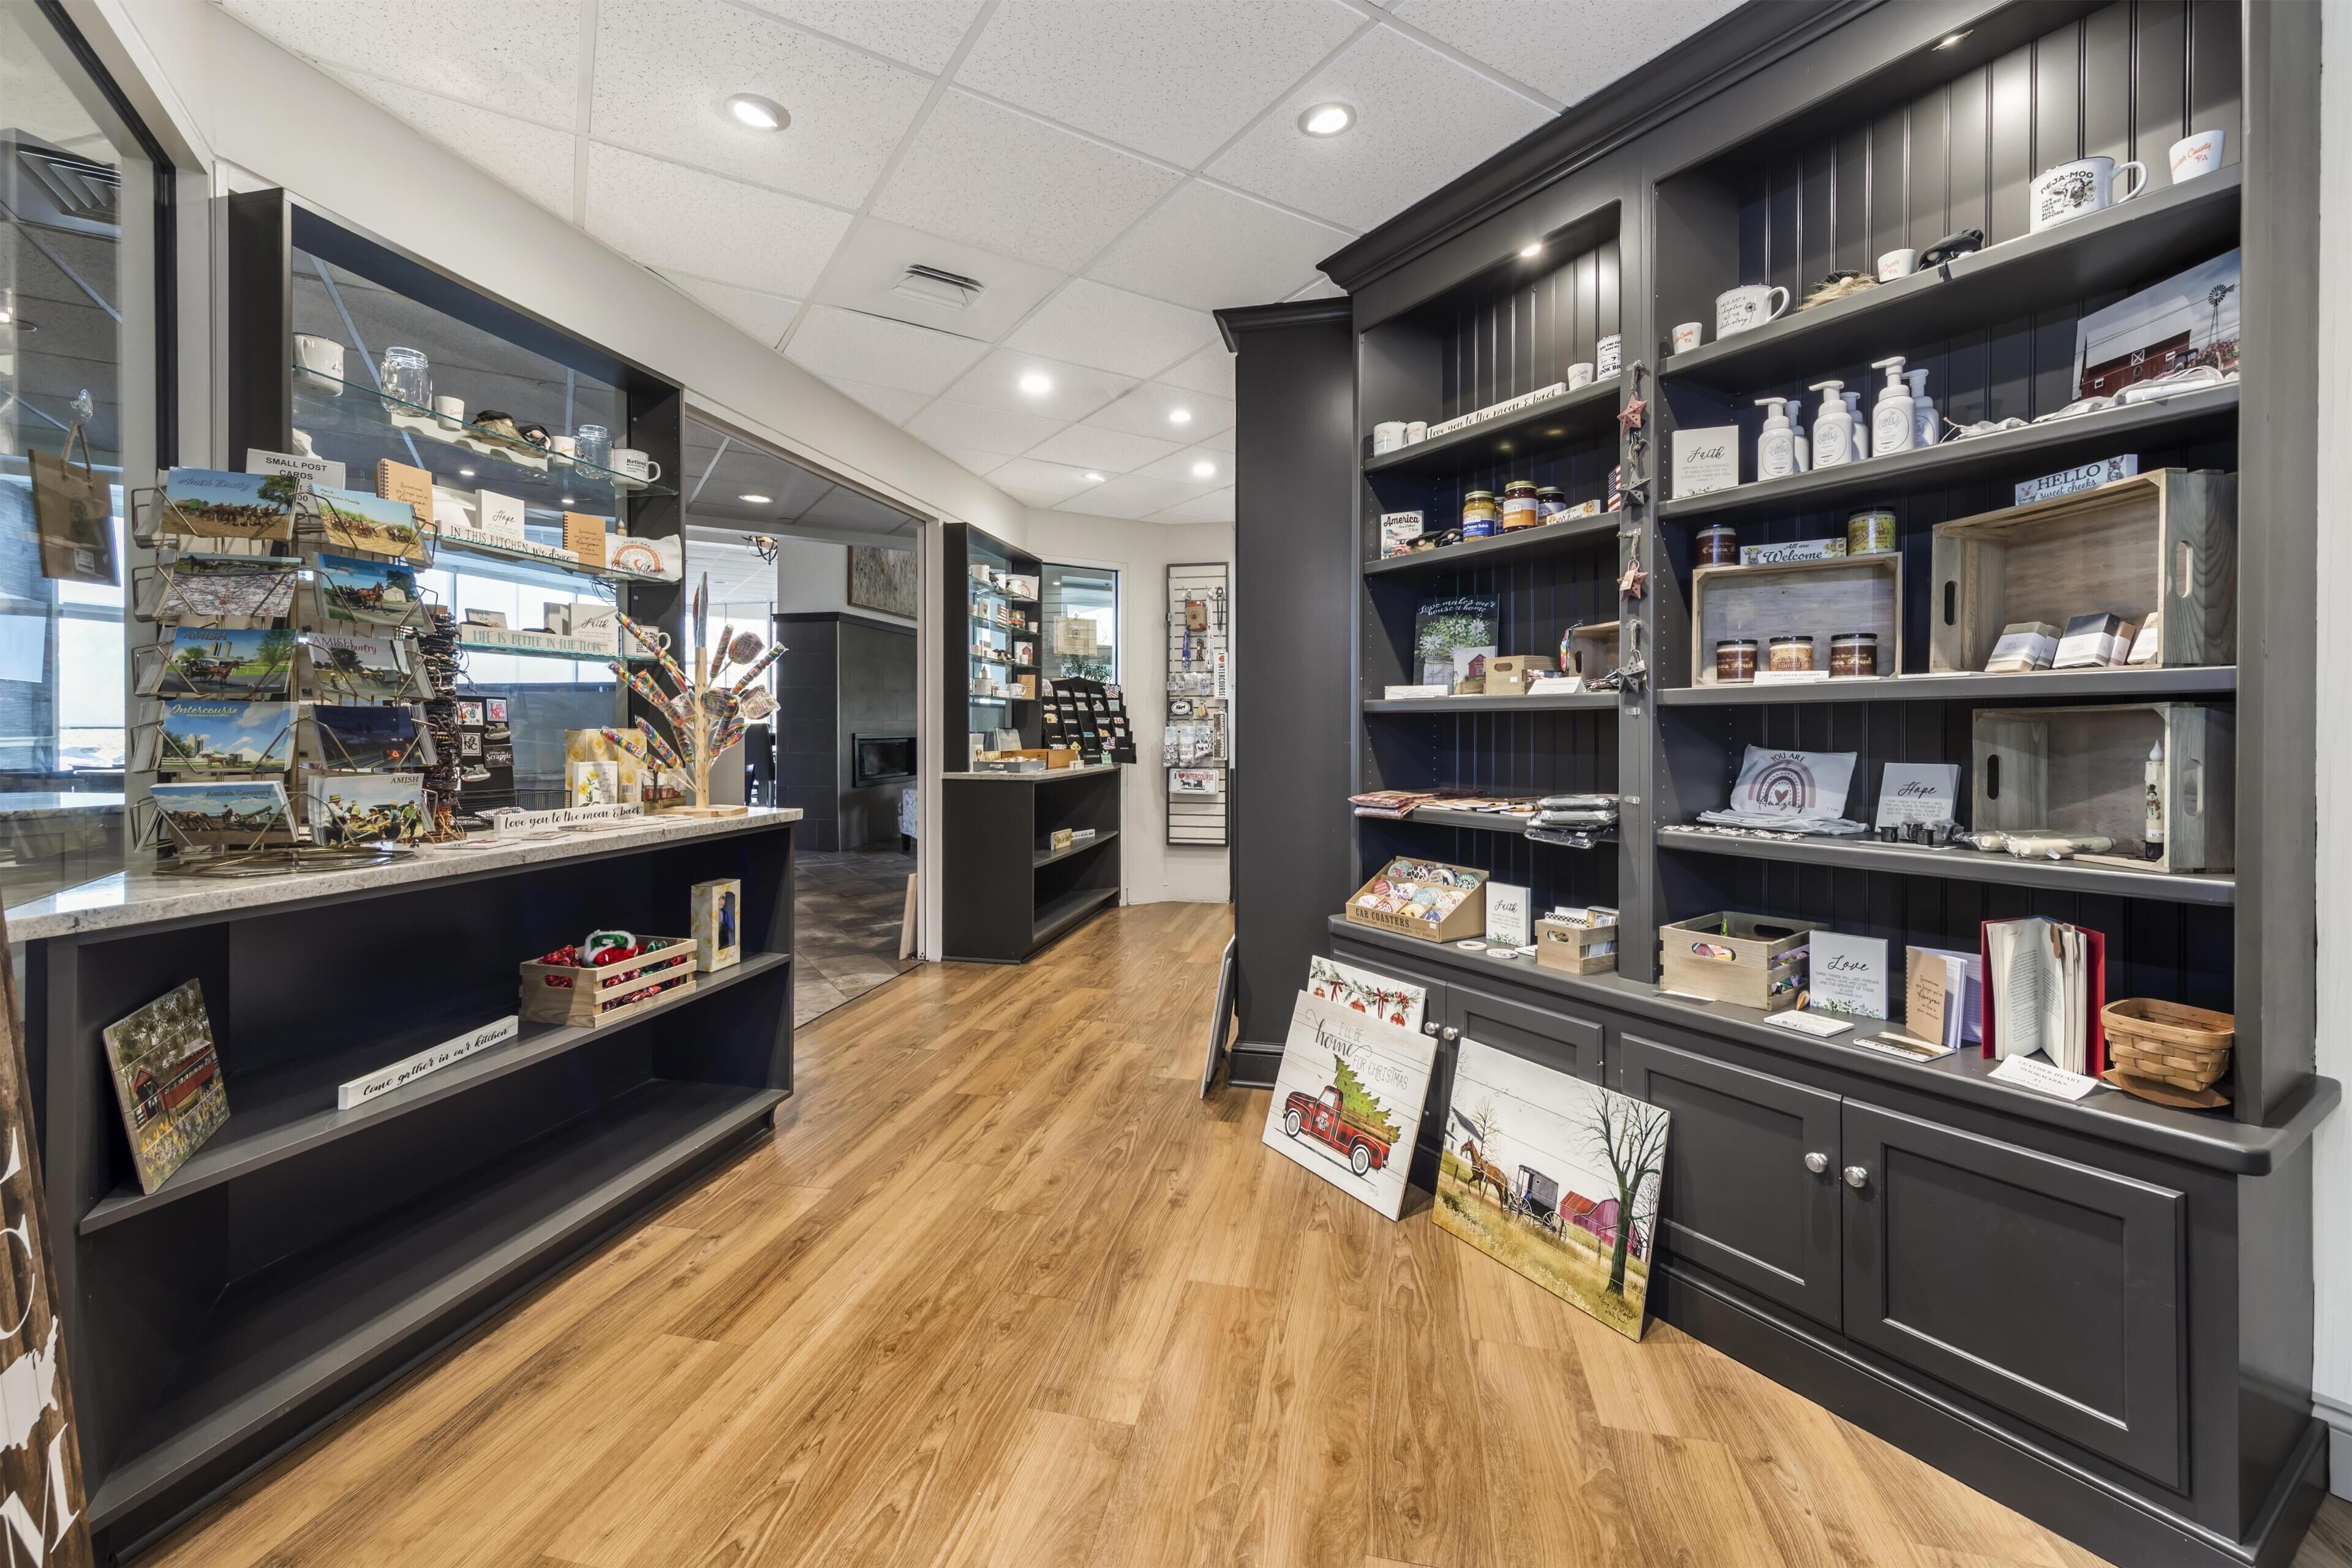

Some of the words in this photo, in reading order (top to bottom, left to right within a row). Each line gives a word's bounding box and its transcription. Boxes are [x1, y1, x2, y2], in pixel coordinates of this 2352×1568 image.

[2188, 142, 2211, 157] County
[2041, 171, 2094, 194] DEJA-MOO
[2042, 198, 2062, 209] HEARD
[2041, 209, 2064, 221] BEFORE
[1599, 368, 1610, 376] LOOK
[1448, 421, 1463, 432] you
[1466, 417, 1474, 427] to
[1476, 411, 1490, 423] the
[1493, 403, 1520, 417] moon
[1533, 389, 1556, 404] back
[1687, 446, 1725, 463] Faith
[266, 457, 298, 468] SMALL
[301, 462, 328, 472] POST
[627, 458, 647, 467] Retired
[279, 470, 313, 480] CARDS
[2037, 464, 2101, 491] HELLO
[2039, 486, 2065, 499] sweet
[2067, 478, 2097, 492] cheeks
[492, 509, 515, 525] Hope
[1383, 514, 1420, 527] America
[450, 525, 461, 537] IN
[466, 529, 487, 543] THIS
[490, 534, 529, 553] KITCHEN
[1762, 550, 1823, 563] Welcome
[1418, 603, 1441, 614] Love
[1442, 597, 1474, 608] makes
[1476, 600, 1498, 608] our
[1428, 606, 1453, 616] house
[1463, 604, 1487, 613] home
[581, 617, 609, 629] Faith
[183, 631, 227, 641] AMISH
[313, 636, 353, 647] AMISH
[473, 630, 491, 642] LIFE
[497, 631, 506, 644] IS
[511, 633, 541, 647] BETTER
[546, 636, 555, 649] IN
[559, 639, 575, 650] FLIP
[577, 640, 601, 653] FLOPS
[347, 643, 377, 656] country
[170, 704, 239, 715] Intercourse
[486, 752, 512, 761] Scrapple
[1770, 752, 1786, 762] YOU
[1789, 753, 1806, 763] ARE
[1898, 781, 1937, 799] Hope
[1755, 794, 1806, 814] Amazing
[529, 818, 550, 828] you
[552, 812, 561, 823] to
[564, 812, 580, 822] the
[612, 808, 619, 818] &
[620, 805, 643, 815] back
[1494, 899, 1518, 913] Faith
[1355, 908, 1369, 919] CAR
[1371, 911, 1409, 928] COASTERS
[1827, 955, 1869, 971] Love
[1920, 974, 1939, 987] Sometimes
[1305, 1009, 1373, 1058] home
[1338, 1022, 1352, 1039] I'LL
[1353, 1028, 1364, 1043] BE
[363, 1077, 393, 1096] Come
[397, 1057, 435, 1086] gather
[439, 1053, 451, 1063] in
[454, 1041, 471, 1057] our
[475, 1028, 508, 1048] kitchen
[1352, 1055, 1367, 1071] FOR
[1368, 1061, 1409, 1090] CHRISTMAS
[2018, 1060, 2053, 1075] LEATHER
[2054, 1072, 2082, 1084] HEART
[2019, 1066, 2068, 1086] BOOKMARKS
[1316, 1116, 1325, 1125] FRESH
[1317, 1123, 1325, 1131] TREES
